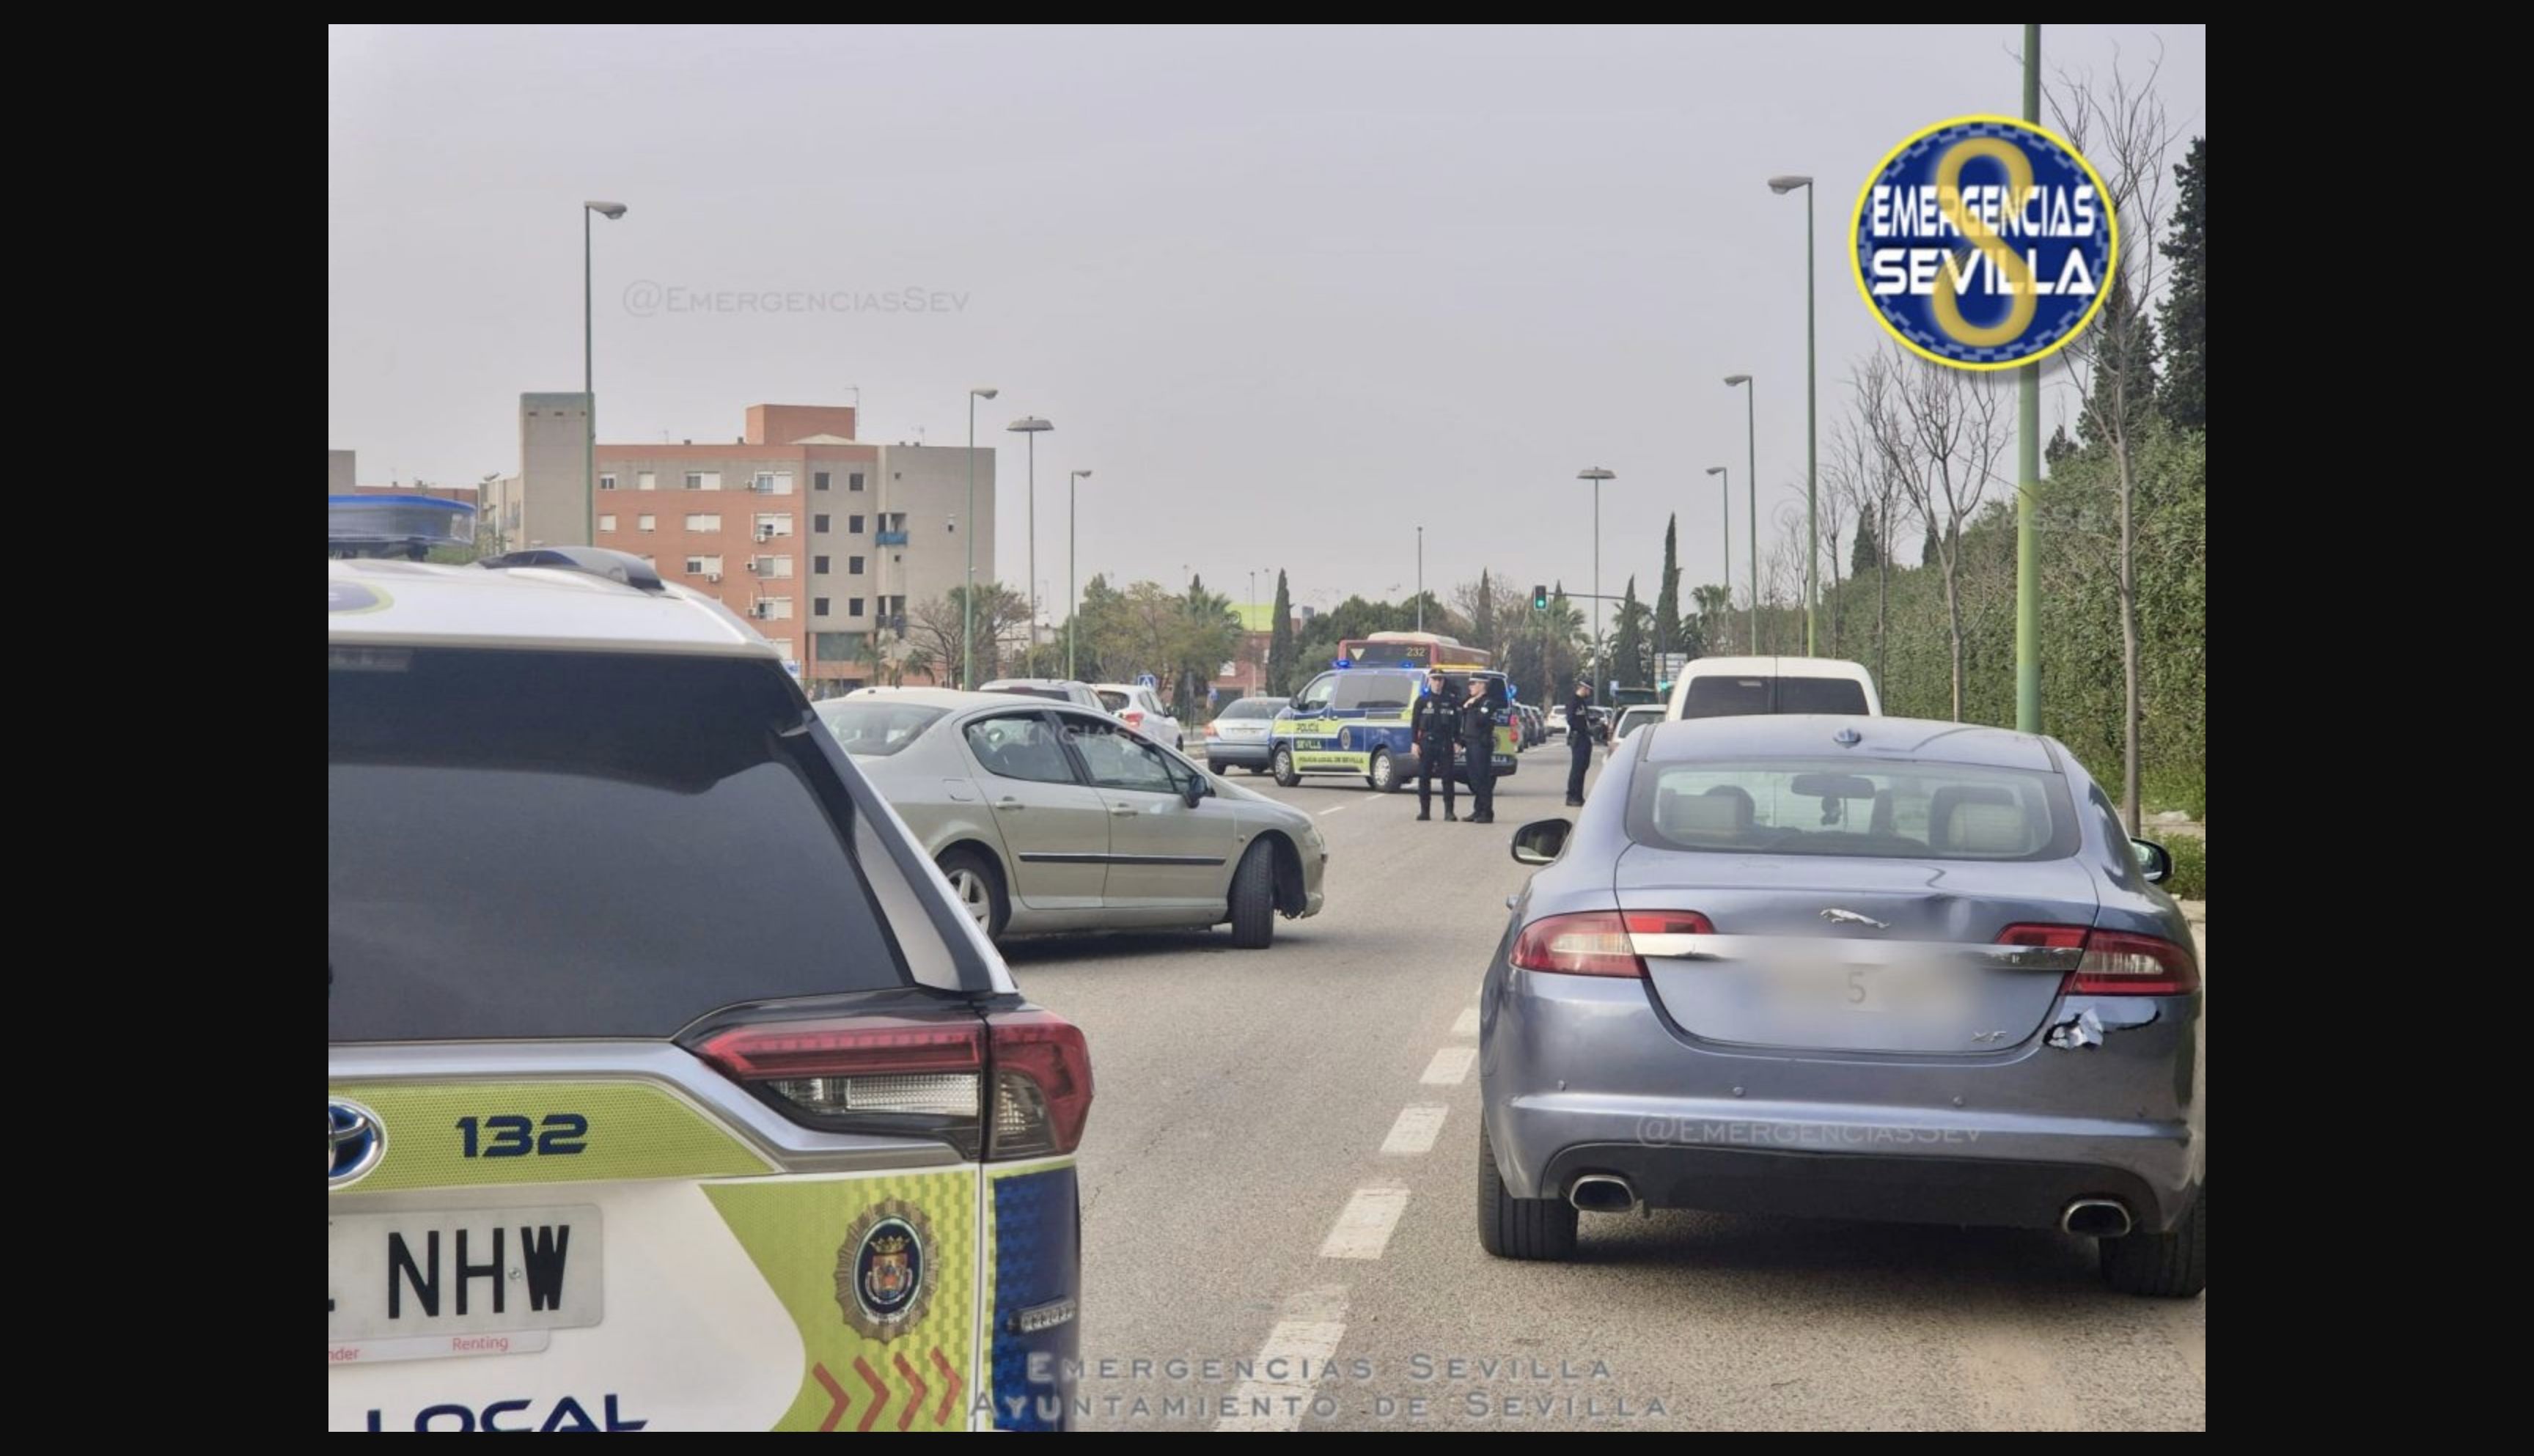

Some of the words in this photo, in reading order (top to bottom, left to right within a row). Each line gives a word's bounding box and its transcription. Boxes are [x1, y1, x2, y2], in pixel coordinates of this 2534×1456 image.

[1407, 647, 1425, 657] 232
[1296, 740, 1322, 749] SEVILLA
[1970, 1031, 2007, 1042] XF
[456, 1114, 588, 1158] 132
[388, 1225, 570, 1320] NHW
[452, 1336, 509, 1351] Renting
